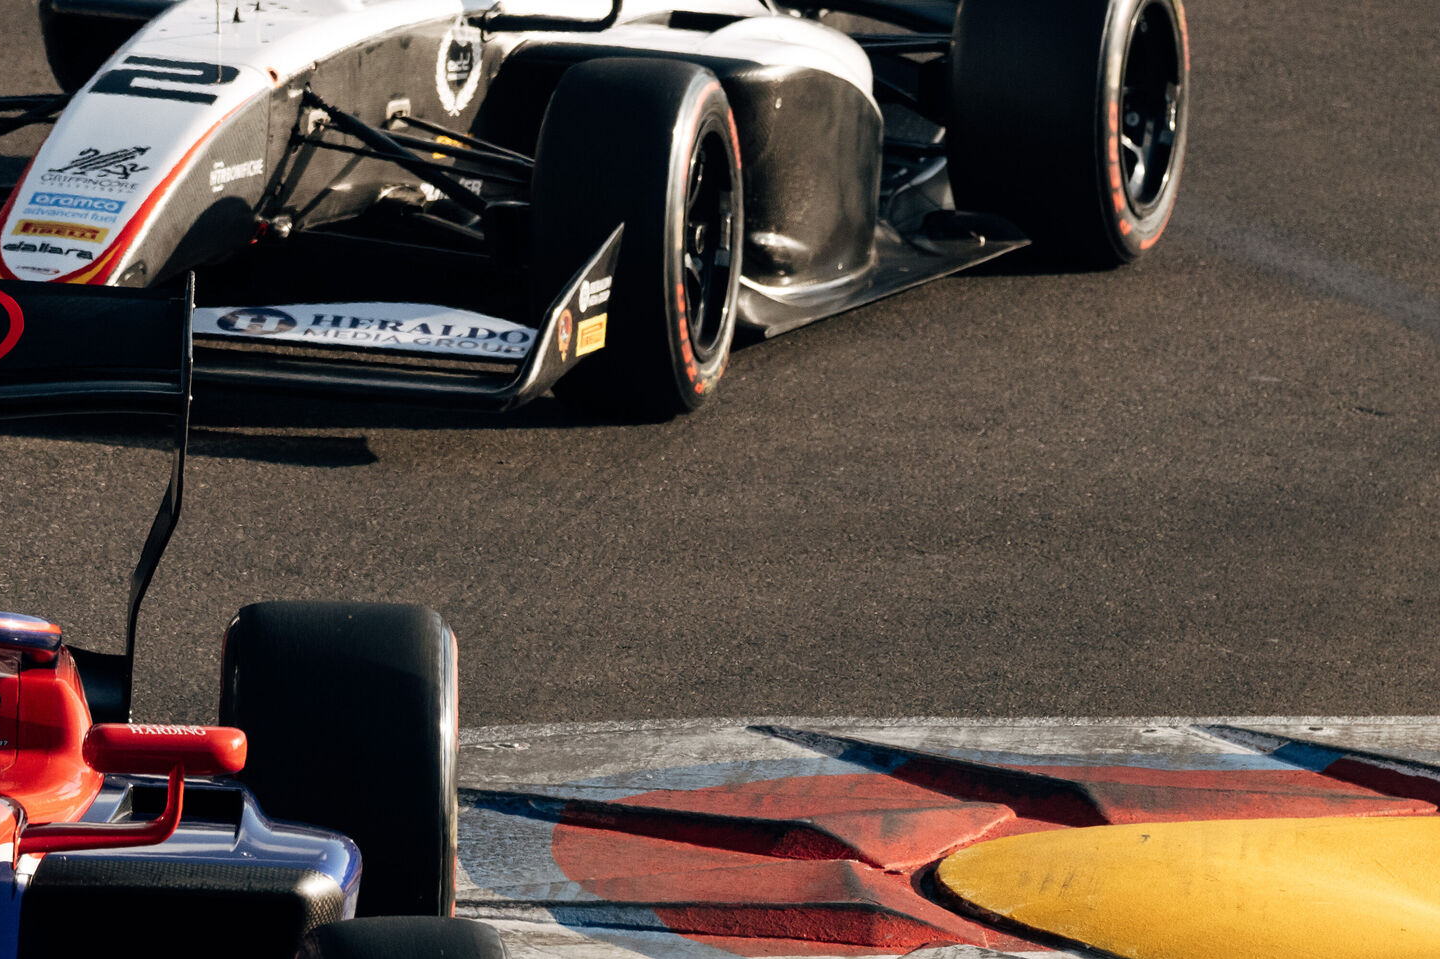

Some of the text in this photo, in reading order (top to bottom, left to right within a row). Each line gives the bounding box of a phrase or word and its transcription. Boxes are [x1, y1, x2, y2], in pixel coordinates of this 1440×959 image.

[88, 55, 240, 105] 2
[35, 194, 119, 212] aramco
[23, 206, 88, 221] advanced
[20, 222, 100, 241] PIRELLI
[3, 241, 94, 261] dallara
[310, 313, 531, 344] HERALDO
[303, 328, 526, 354] MEDIA GROUP
[127, 723, 207, 736] HARDING
